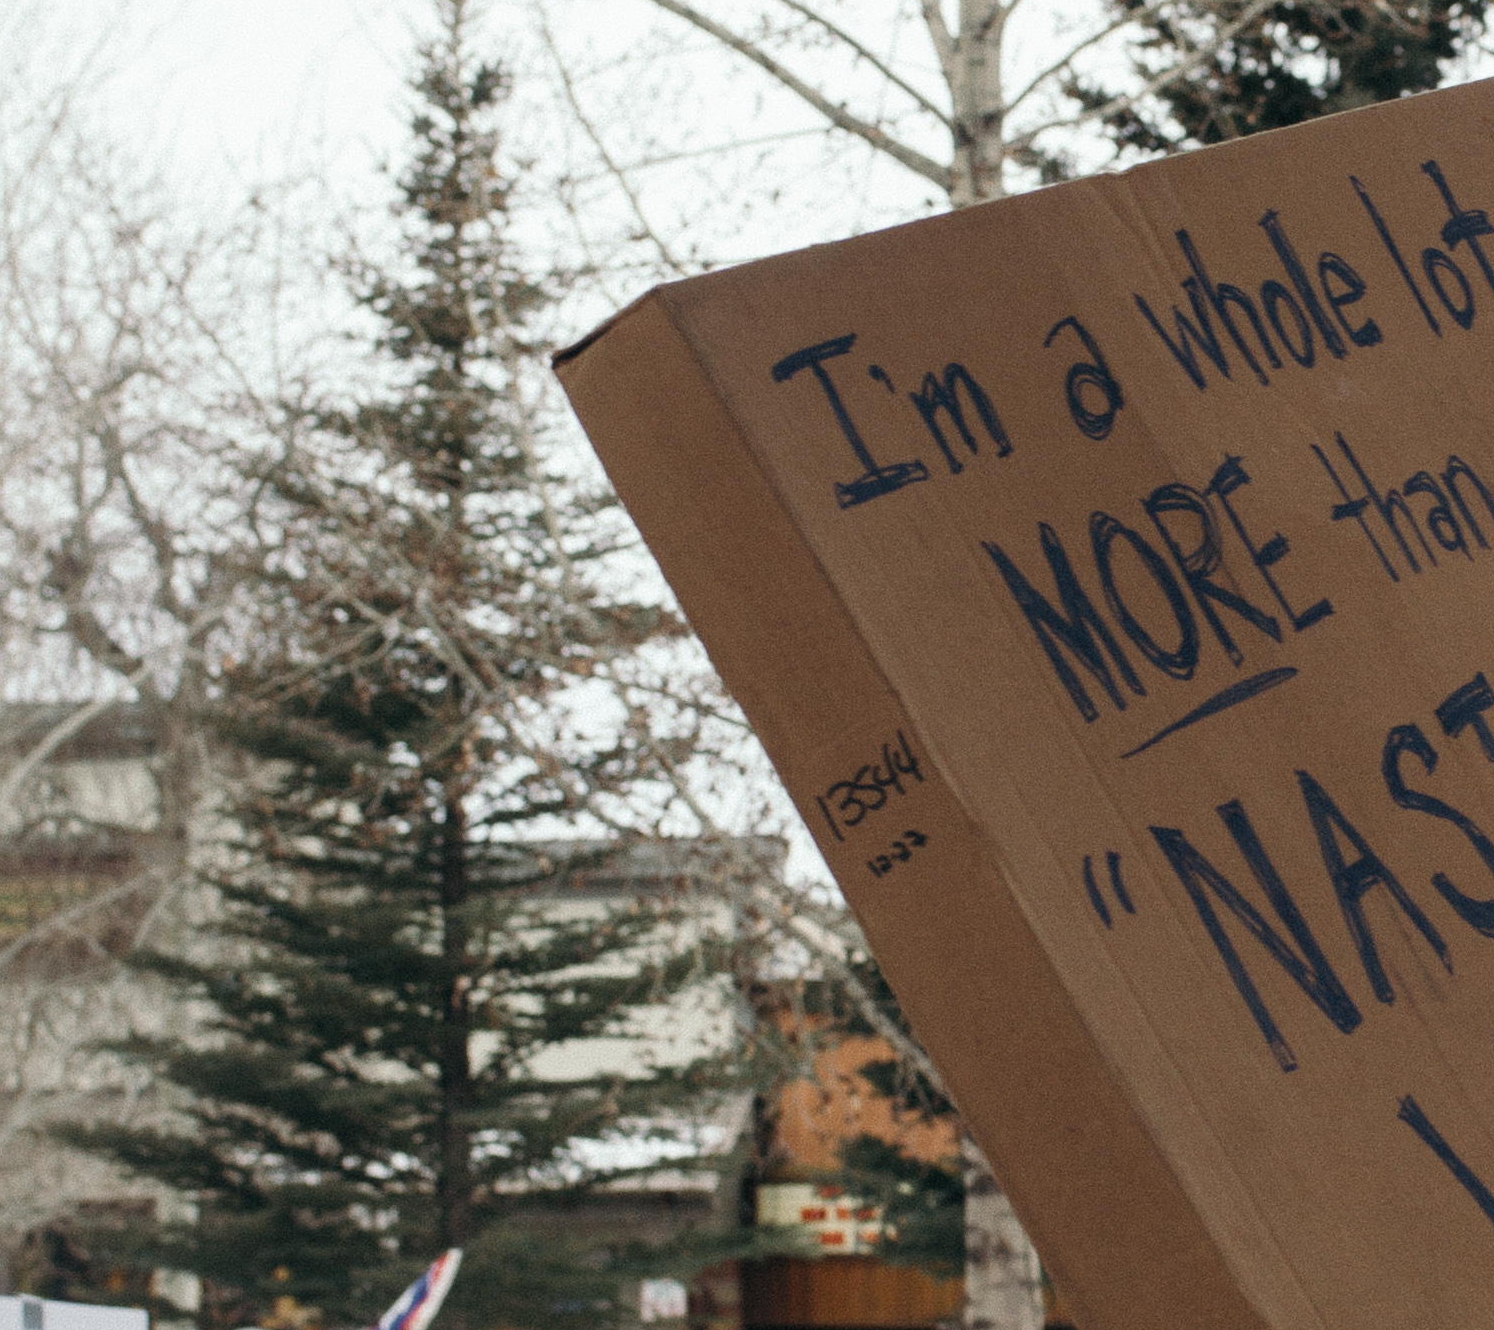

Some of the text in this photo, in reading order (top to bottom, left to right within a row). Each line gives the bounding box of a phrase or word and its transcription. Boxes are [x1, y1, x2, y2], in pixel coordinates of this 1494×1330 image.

[772, 332, 1015, 508] I'm
[1044, 316, 1126, 440] a
[1134, 207, 1383, 391] whole
[981, 454, 1334, 723] MORE
